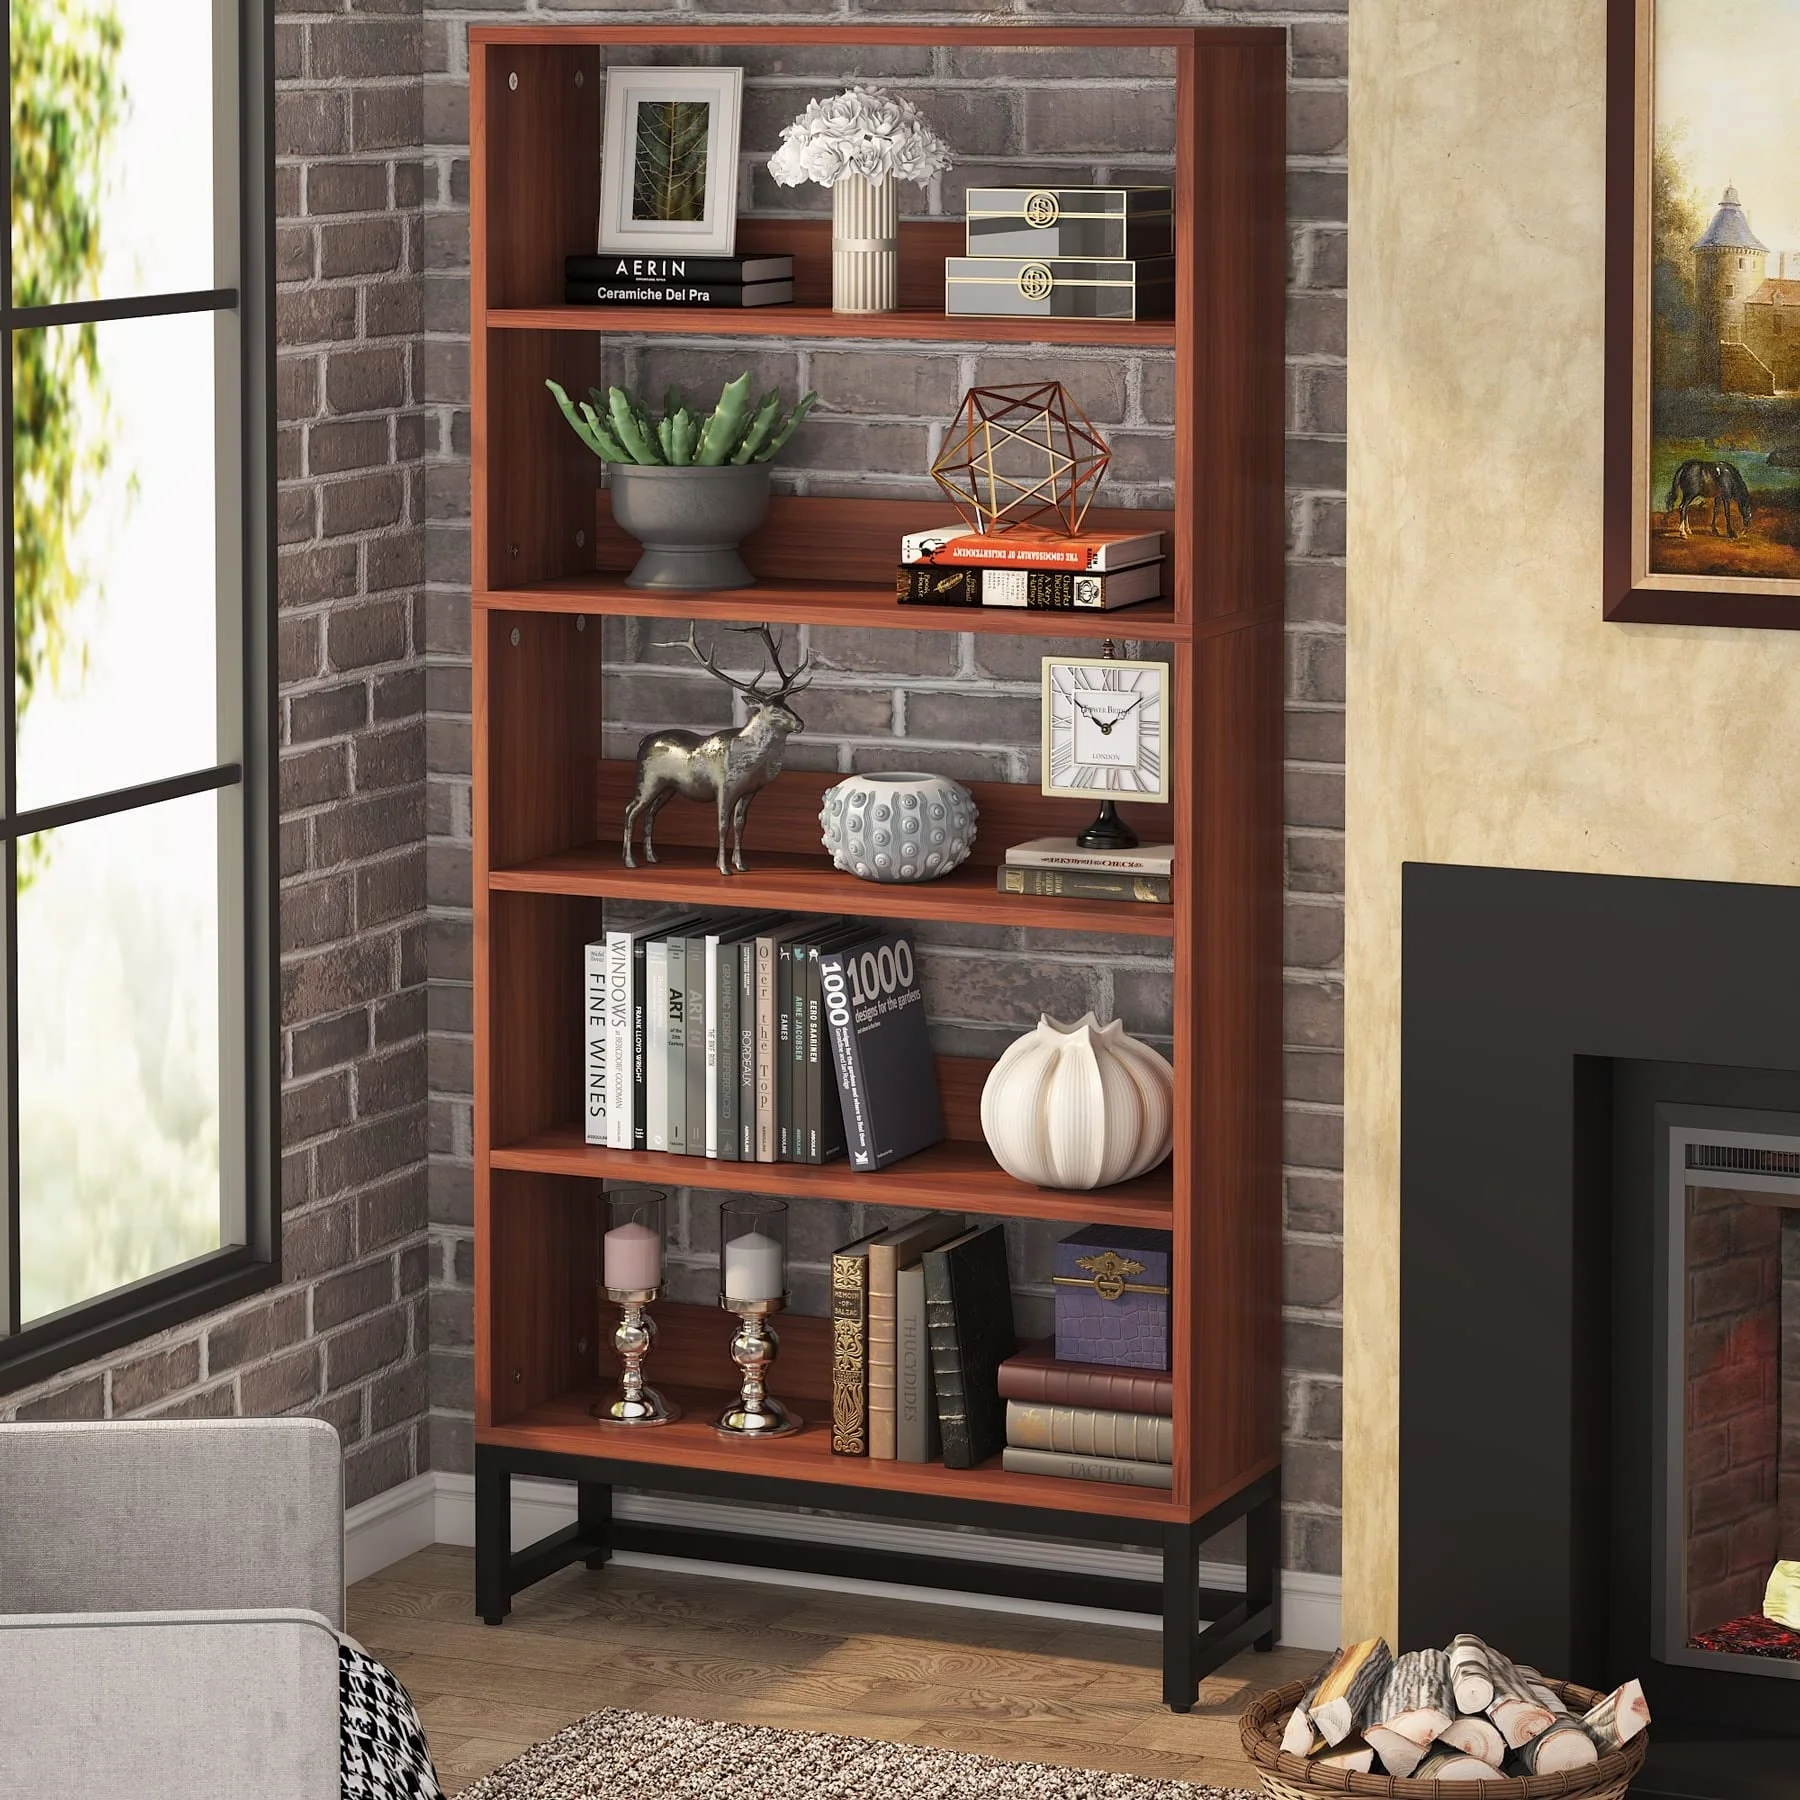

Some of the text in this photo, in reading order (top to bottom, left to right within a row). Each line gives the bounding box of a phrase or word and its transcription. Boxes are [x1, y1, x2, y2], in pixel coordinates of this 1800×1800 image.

[615, 259, 685, 277] AERIN
[597, 287, 710, 302] Ceramiche Del Pra
[1008, 550, 1016, 560] OF
[1016, 550, 1064, 561] COMMISSARIAT
[1065, 552, 1079, 562] THE
[1062, 575, 1071, 606] Charles
[1092, 752, 1121, 761] LONDON
[611, 940, 627, 1028] WINDOWS
[846, 940, 914, 1007] 1000
[590, 973, 606, 1027] FINE
[669, 988, 683, 1022] ART
[689, 989, 703, 1024] ART
[821, 961, 850, 1026] 1000
[855, 989, 921, 1023] designs for the gardens
[721, 963, 731, 1120] GRAPHIC DESIGN REFERENCED
[759, 946, 769, 1108] Over the Top
[780, 1014, 788, 1041] EAMES
[795, 996, 803, 1061] ARNE JACOBSEN
[809, 1000, 818, 1063] EERO SAARINEN
[615, 1036, 623, 1073] BERGDORF
[742, 1030, 752, 1087] BORDEAUX
[590, 1038, 606, 1118] WINES
[615, 1073, 623, 1110] GOODMAN
[903, 1315, 918, 1423] THUCYDIDES
[1067, 1461, 1136, 1482] TACITUS
